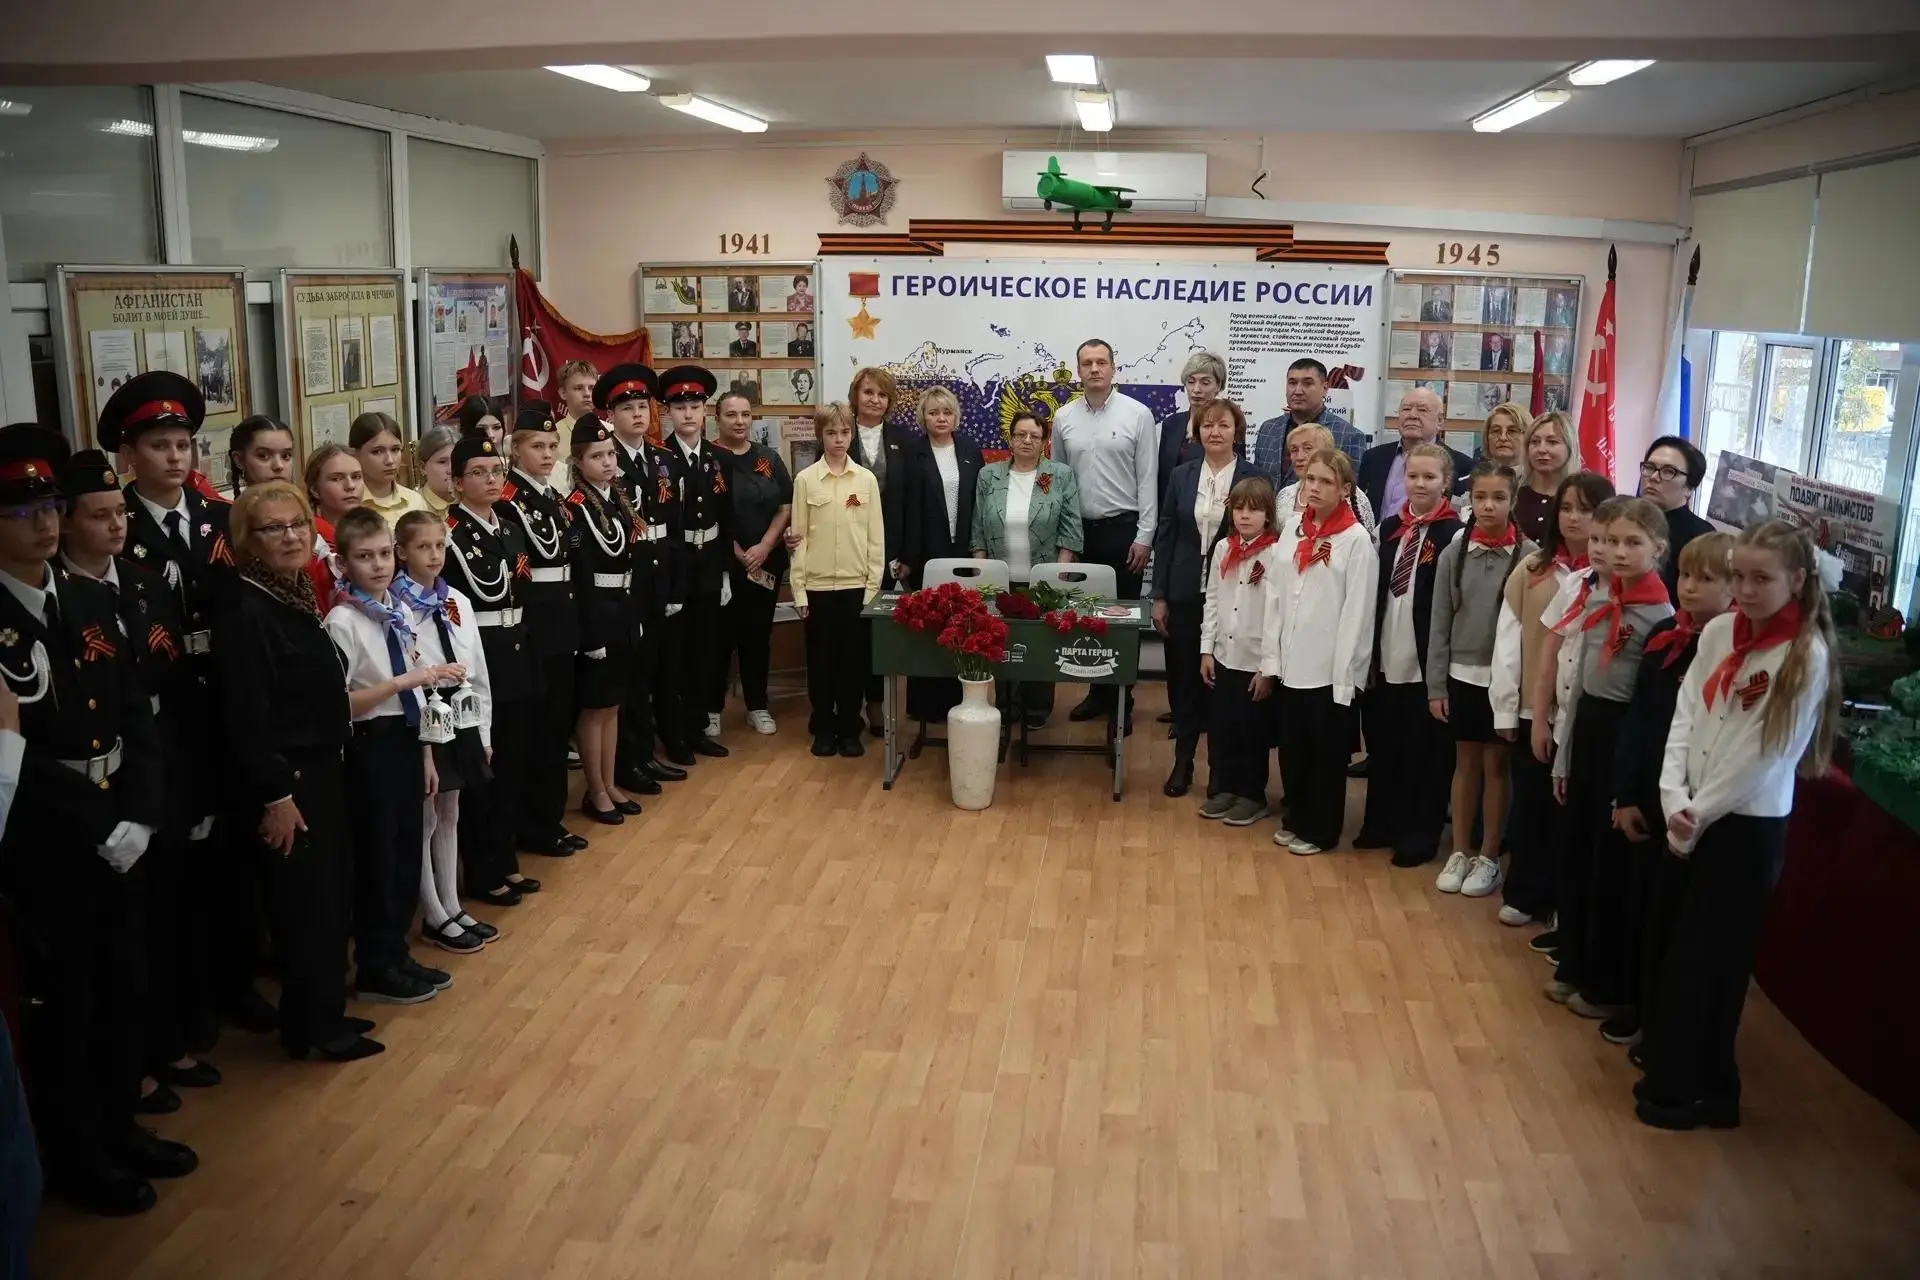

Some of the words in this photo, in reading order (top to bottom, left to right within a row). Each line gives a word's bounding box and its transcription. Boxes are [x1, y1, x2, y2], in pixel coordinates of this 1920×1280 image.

[719, 232, 770, 254] 1941
[1436, 242, 1500, 266] 1945
[296, 290, 324, 304] СУДЬБА
[326, 290, 366, 302] ЗАБРОСИЛА
[366, 290, 372, 300] В
[373, 289, 394, 300] ЧЕЧНЮ
[891, 274, 1087, 300] ГЕРОИЧЕСКОЕ
[1096, 277, 1246, 304] НАСЛЕДИЕ
[1255, 281, 1373, 306] РОССИИ
[114, 293, 203, 309] АФГАНИСТАН
[112, 311, 143, 322] БОЛИТ
[146, 311, 152, 322] В
[154, 310, 179, 321] МОЕЙ
[1790, 486, 1822, 512] ПОДВИГ
[1061, 647, 1087, 656] ПАРТА
[1088, 648, 1113, 658] ГЕРОЯ
